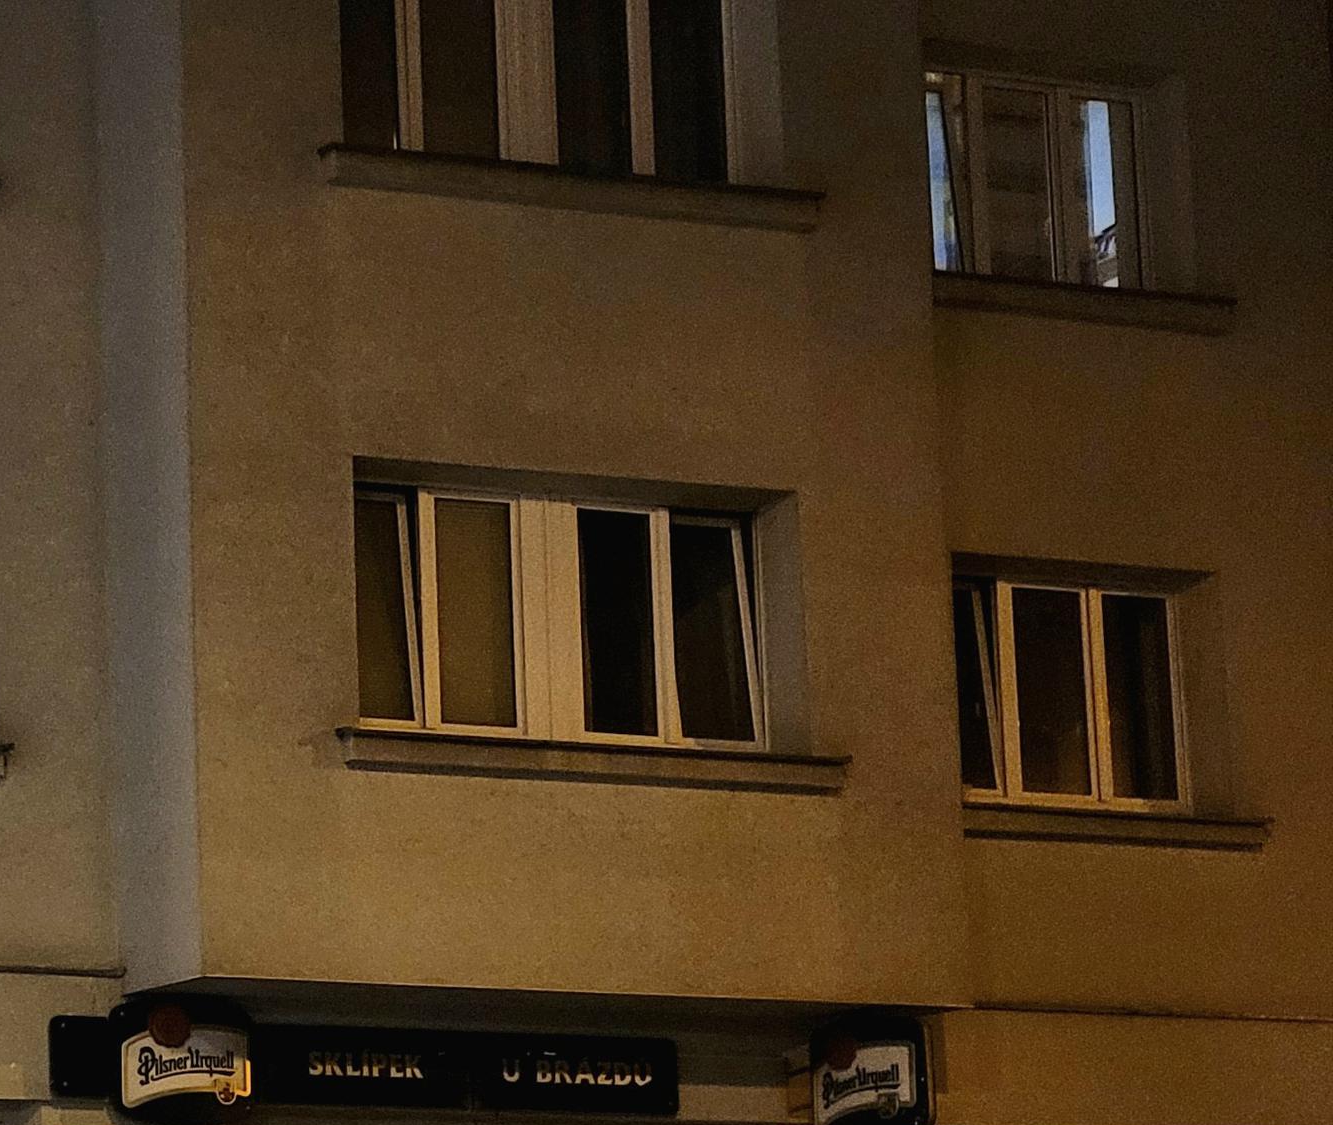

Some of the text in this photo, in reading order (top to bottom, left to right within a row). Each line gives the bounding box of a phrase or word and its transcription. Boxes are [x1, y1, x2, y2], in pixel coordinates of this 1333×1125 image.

[137, 1046, 235, 1086] Pilsner Urquell
[308, 1048, 425, 1079] SKLÍPEK
[501, 1057, 521, 1083] U
